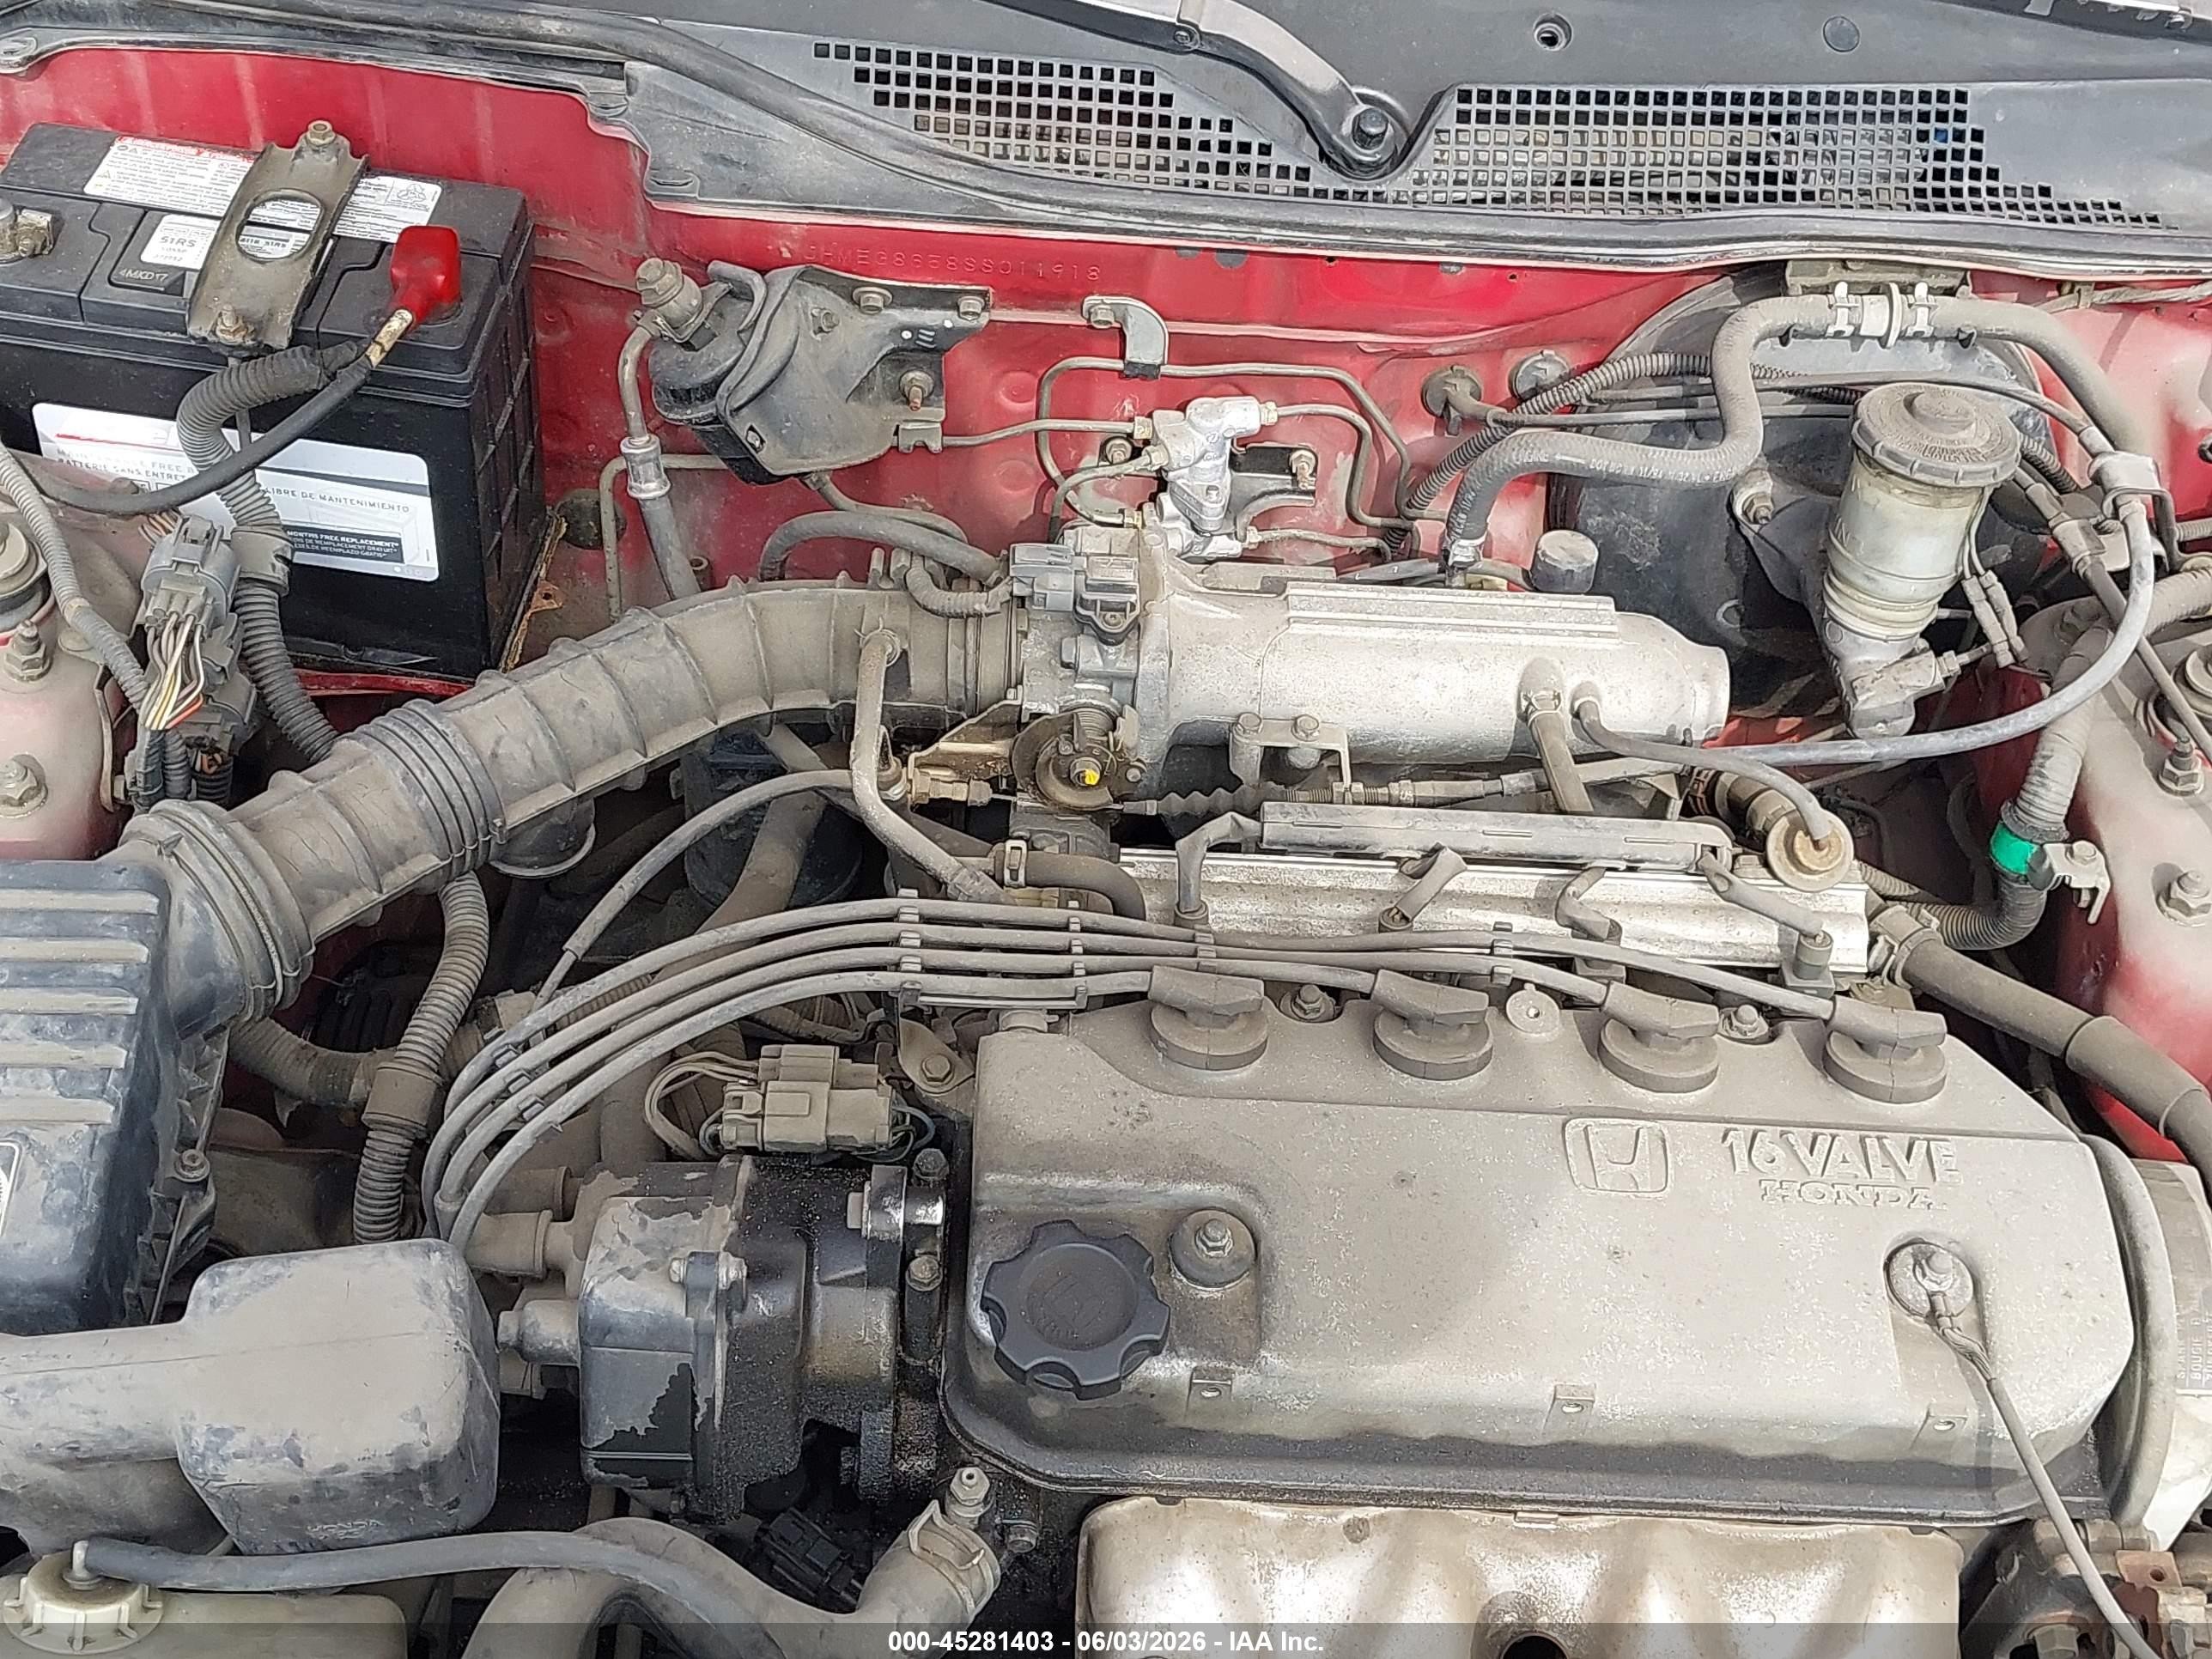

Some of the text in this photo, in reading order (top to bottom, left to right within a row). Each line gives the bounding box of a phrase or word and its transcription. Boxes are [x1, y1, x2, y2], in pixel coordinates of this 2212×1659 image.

[301, 491, 315, 501] DE
[319, 495, 410, 514] MANTENIMIENTO
[1759, 1178, 1948, 1211] HONDA
[2191, 1336, 2203, 1380] BOUGIE
